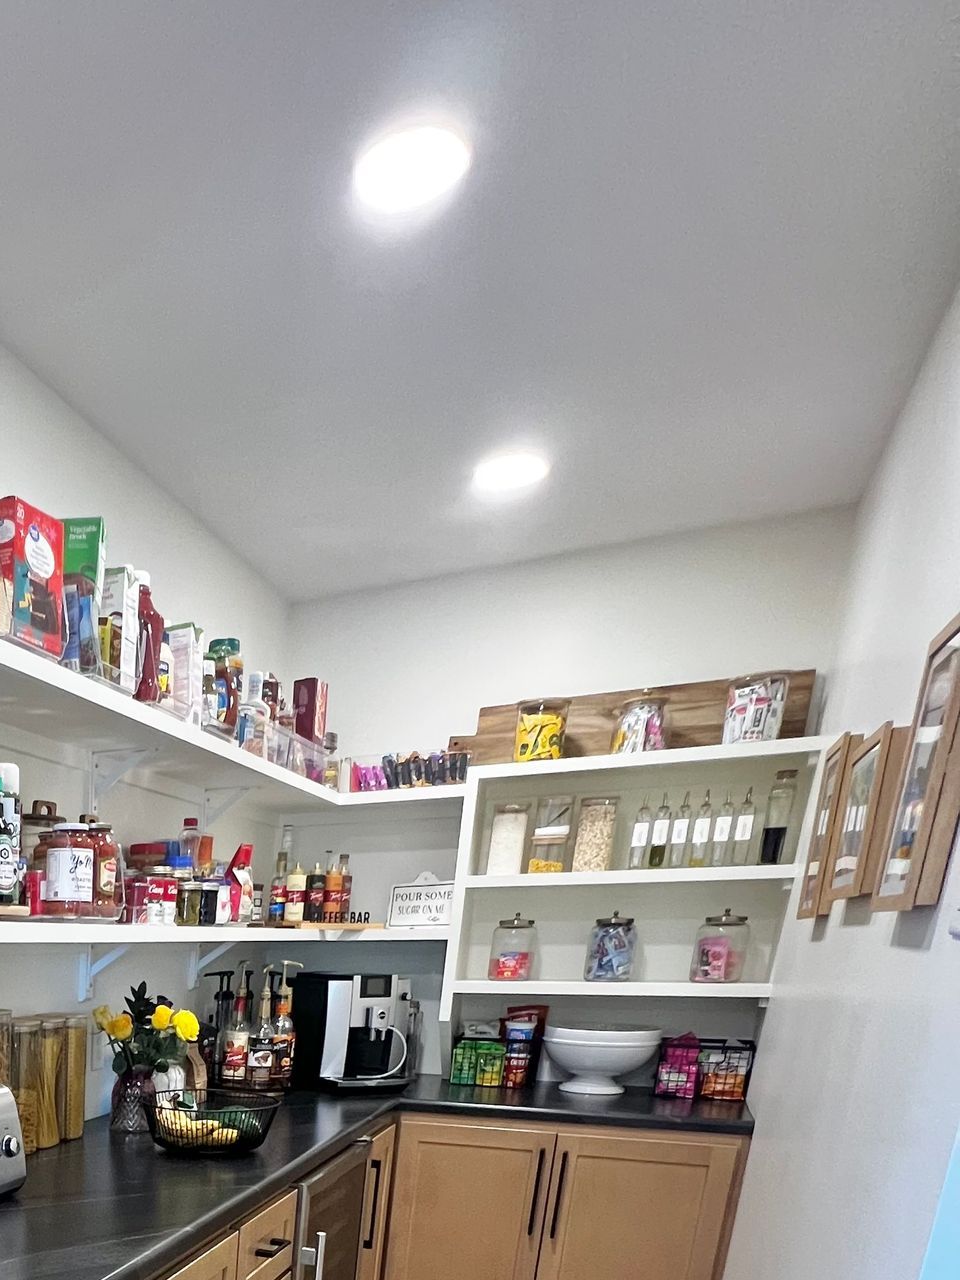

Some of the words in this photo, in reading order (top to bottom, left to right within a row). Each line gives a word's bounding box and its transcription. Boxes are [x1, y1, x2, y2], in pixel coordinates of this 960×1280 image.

[395, 891, 422, 902] POUR
[424, 890, 454, 901] SOME
[309, 911, 346, 924] FFEE
[349, 911, 370, 924] BAR
